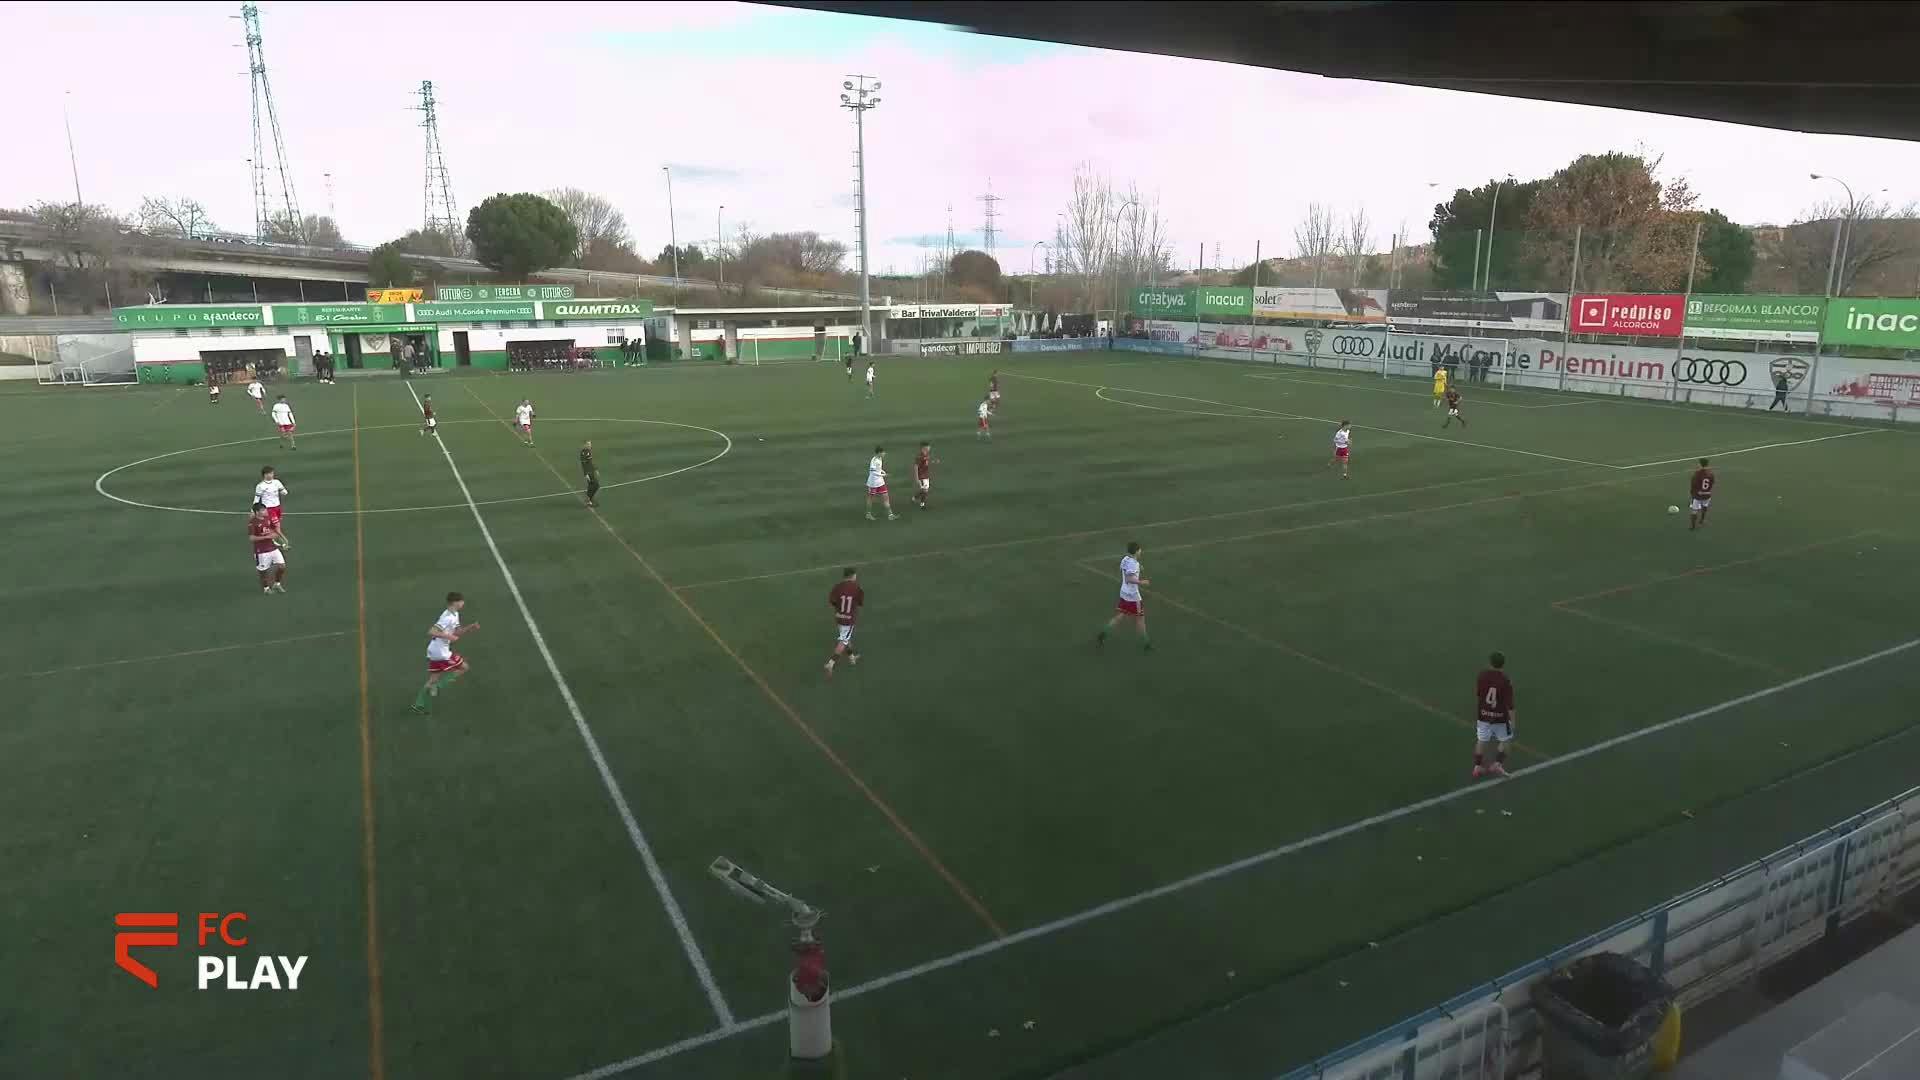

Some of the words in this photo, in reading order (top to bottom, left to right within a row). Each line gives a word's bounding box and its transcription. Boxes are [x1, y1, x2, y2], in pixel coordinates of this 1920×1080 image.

[1205, 291, 1244, 306] inacua
[555, 304, 641, 315] QUAMTRAX
[901, 310, 917, 318] Bar
[1611, 305, 1672, 321] redpiso
[1703, 302, 1758, 315] REFORMAS
[1761, 304, 1820, 316] BLANCOR
[203, 310, 260, 326] afandecor
[1846, 306, 1918, 332] inac
[1377, 340, 1424, 361] Audi
[1539, 351, 1665, 380] Premium
[1702, 478, 1710, 490] 6
[840, 595, 853, 613] 11
[1486, 687, 1497, 708] 4
